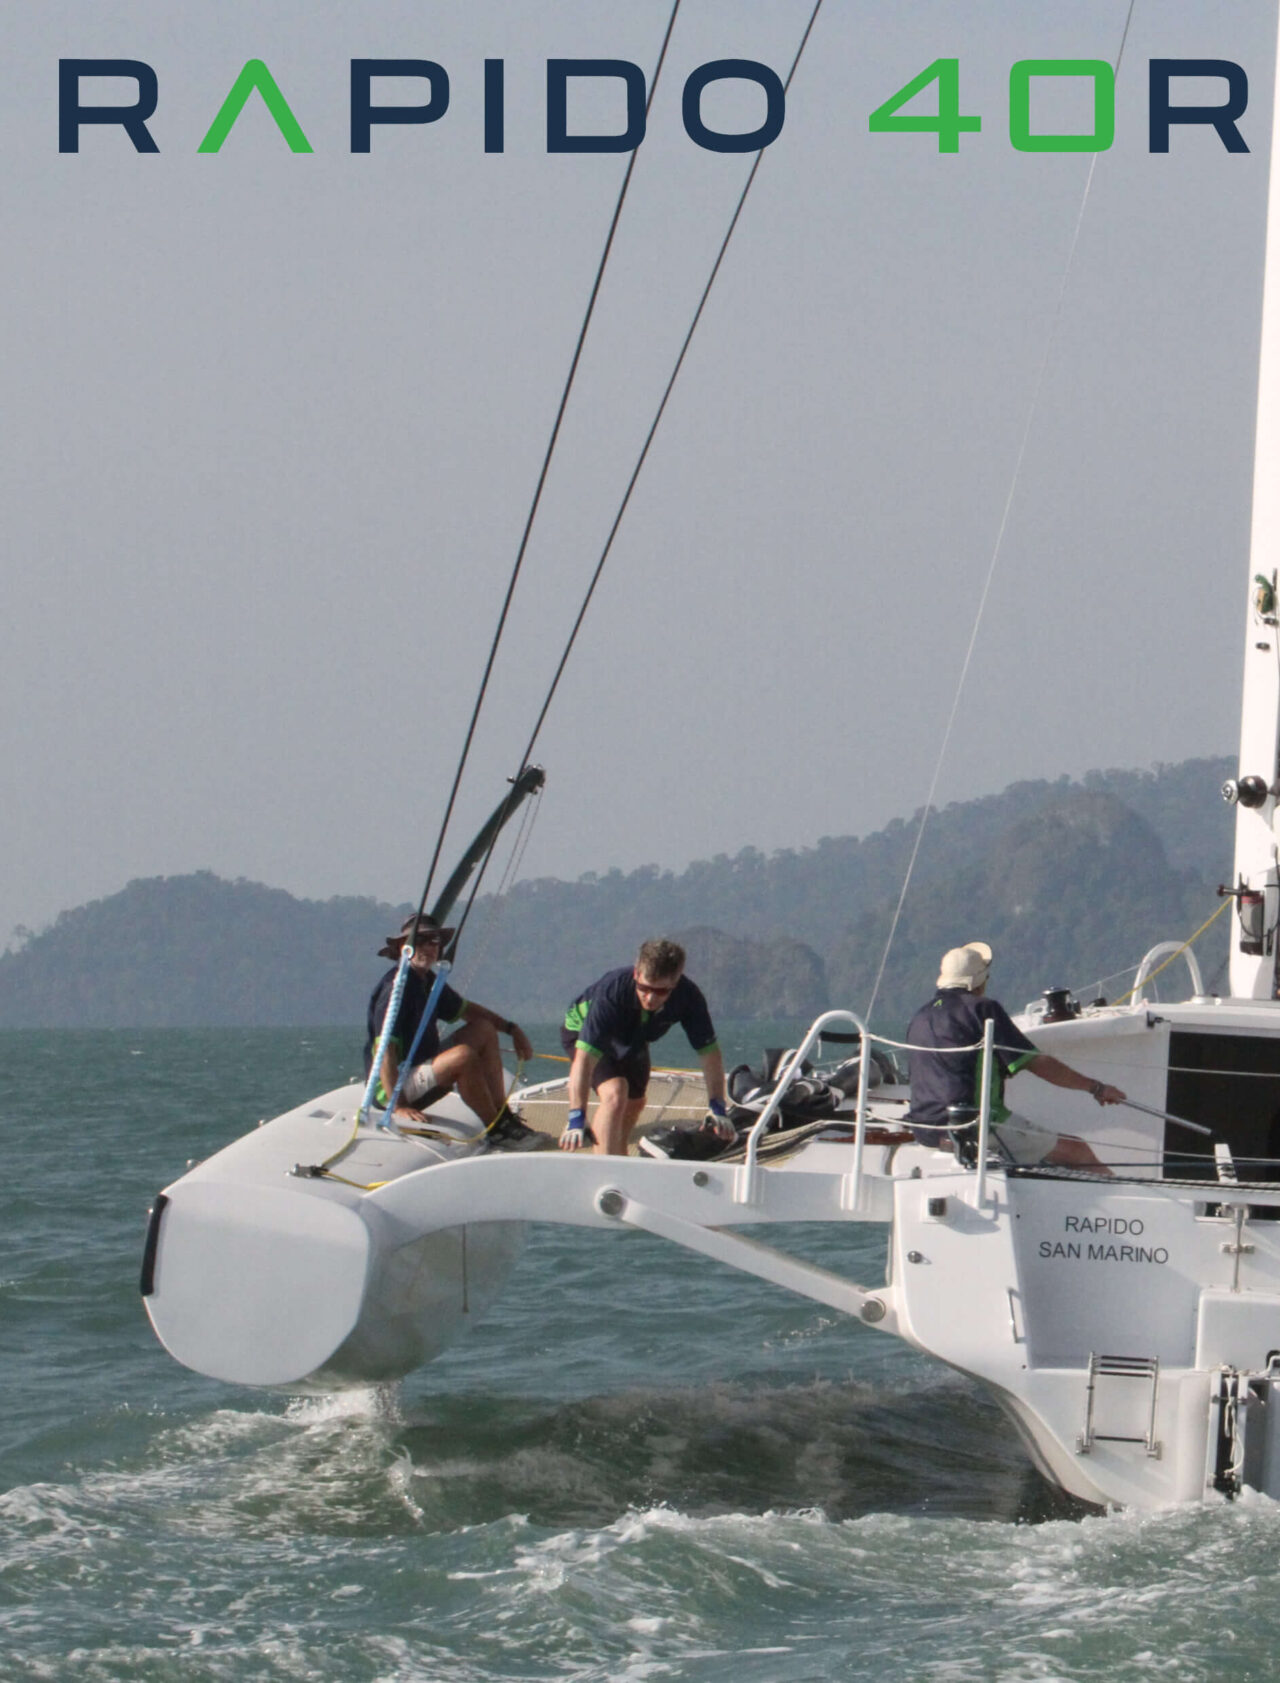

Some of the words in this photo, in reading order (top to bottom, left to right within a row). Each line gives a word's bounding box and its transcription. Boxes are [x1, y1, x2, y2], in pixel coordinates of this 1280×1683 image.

[1065, 1216, 1144, 1236] RAPIDO
[1038, 1241, 1081, 1259] SAN
[1087, 1244, 1169, 1264] MARINO
